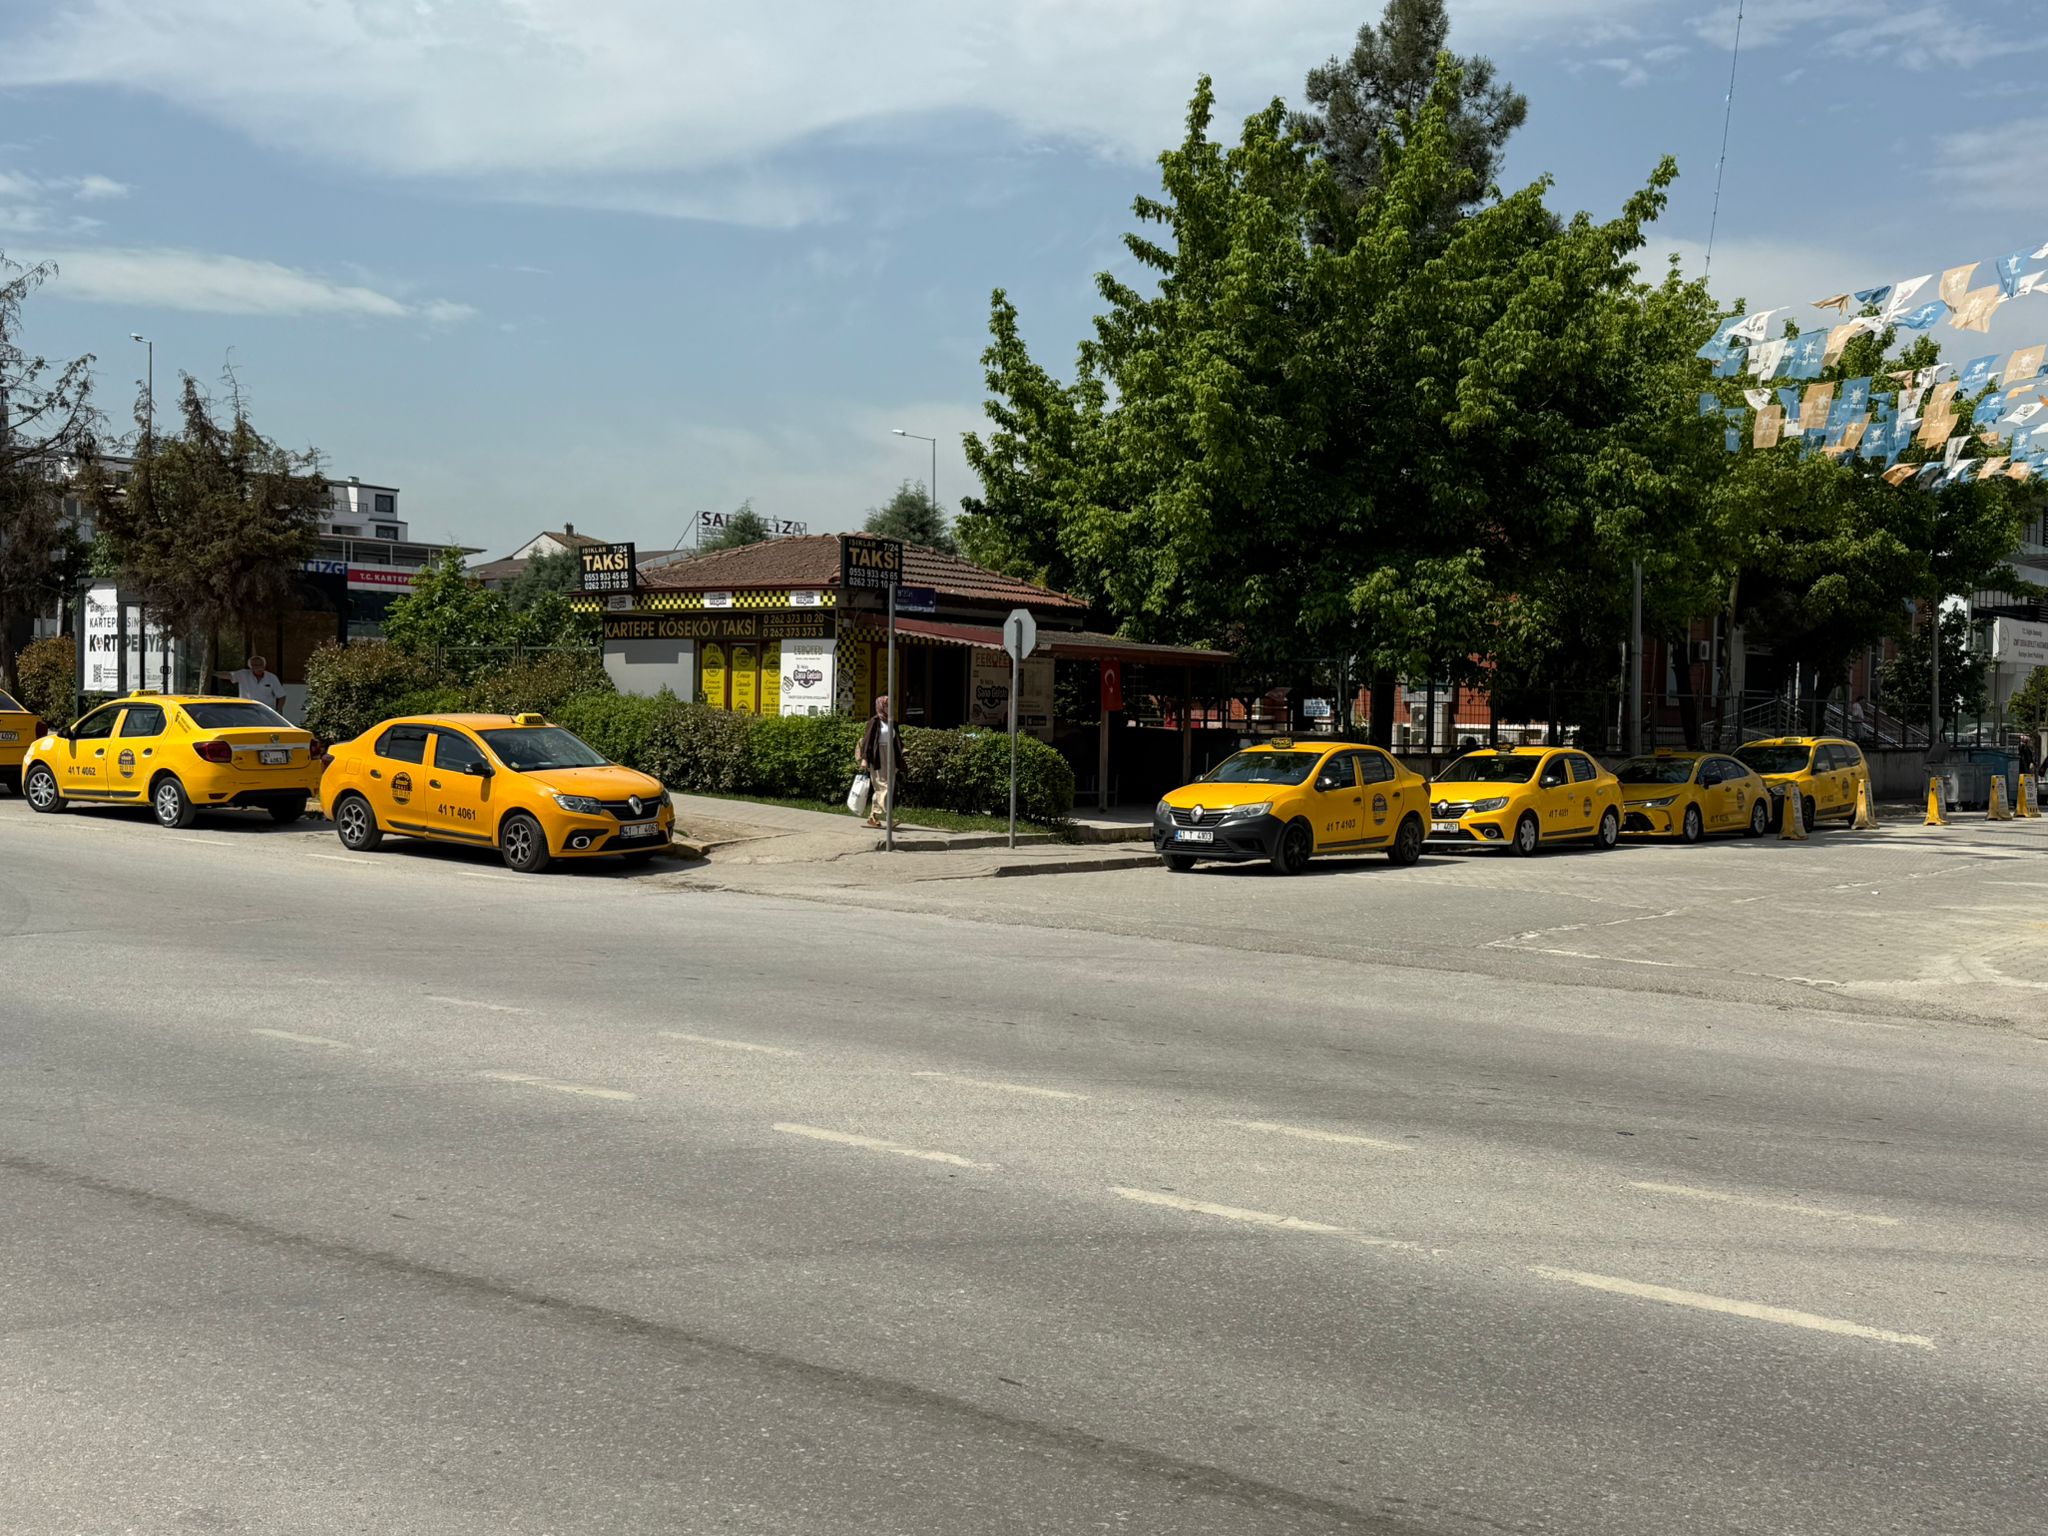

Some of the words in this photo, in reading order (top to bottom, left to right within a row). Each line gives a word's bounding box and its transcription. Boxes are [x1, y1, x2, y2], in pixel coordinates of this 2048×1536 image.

[613, 545, 628, 553] 7/24
[883, 543, 899, 552] 7/24
[374, 574, 409, 584] KARTEP
[584, 573, 599, 582] 0553
[600, 572, 611, 581] 933
[612, 572, 620, 580] 45
[620, 571, 628, 580] 65
[849, 567, 866, 577] 0553
[866, 568, 879, 578] 933
[880, 571, 888, 579] 45
[889, 571, 898, 580] 65
[584, 581, 599, 590] 0262
[600, 581, 611, 589] 373
[612, 581, 620, 589] 10
[621, 580, 629, 588] 20
[849, 577, 866, 586] 0262
[866, 578, 879, 588] 373
[880, 580, 888, 588] 10
[763, 615, 769, 624] 0
[770, 614, 784, 624] 262
[786, 614, 800, 624] 373
[803, 613, 812, 624] 10
[604, 621, 655, 638] KARTEPE
[659, 616, 719, 637] KÖSEKÖY
[762, 628, 769, 637] 0
[770, 627, 784, 637] 262
[785, 627, 800, 637] 373
[818, 627, 824, 637] 3
[68, 766, 75, 775] 41
[76, 766, 80, 775] T
[82, 767, 96, 776] 4062
[438, 803, 447, 815] 41
[450, 805, 455, 817] T
[457, 807, 476, 820] 4061
[1326, 822, 1333, 832] 41
[1335, 821, 1340, 832] T
